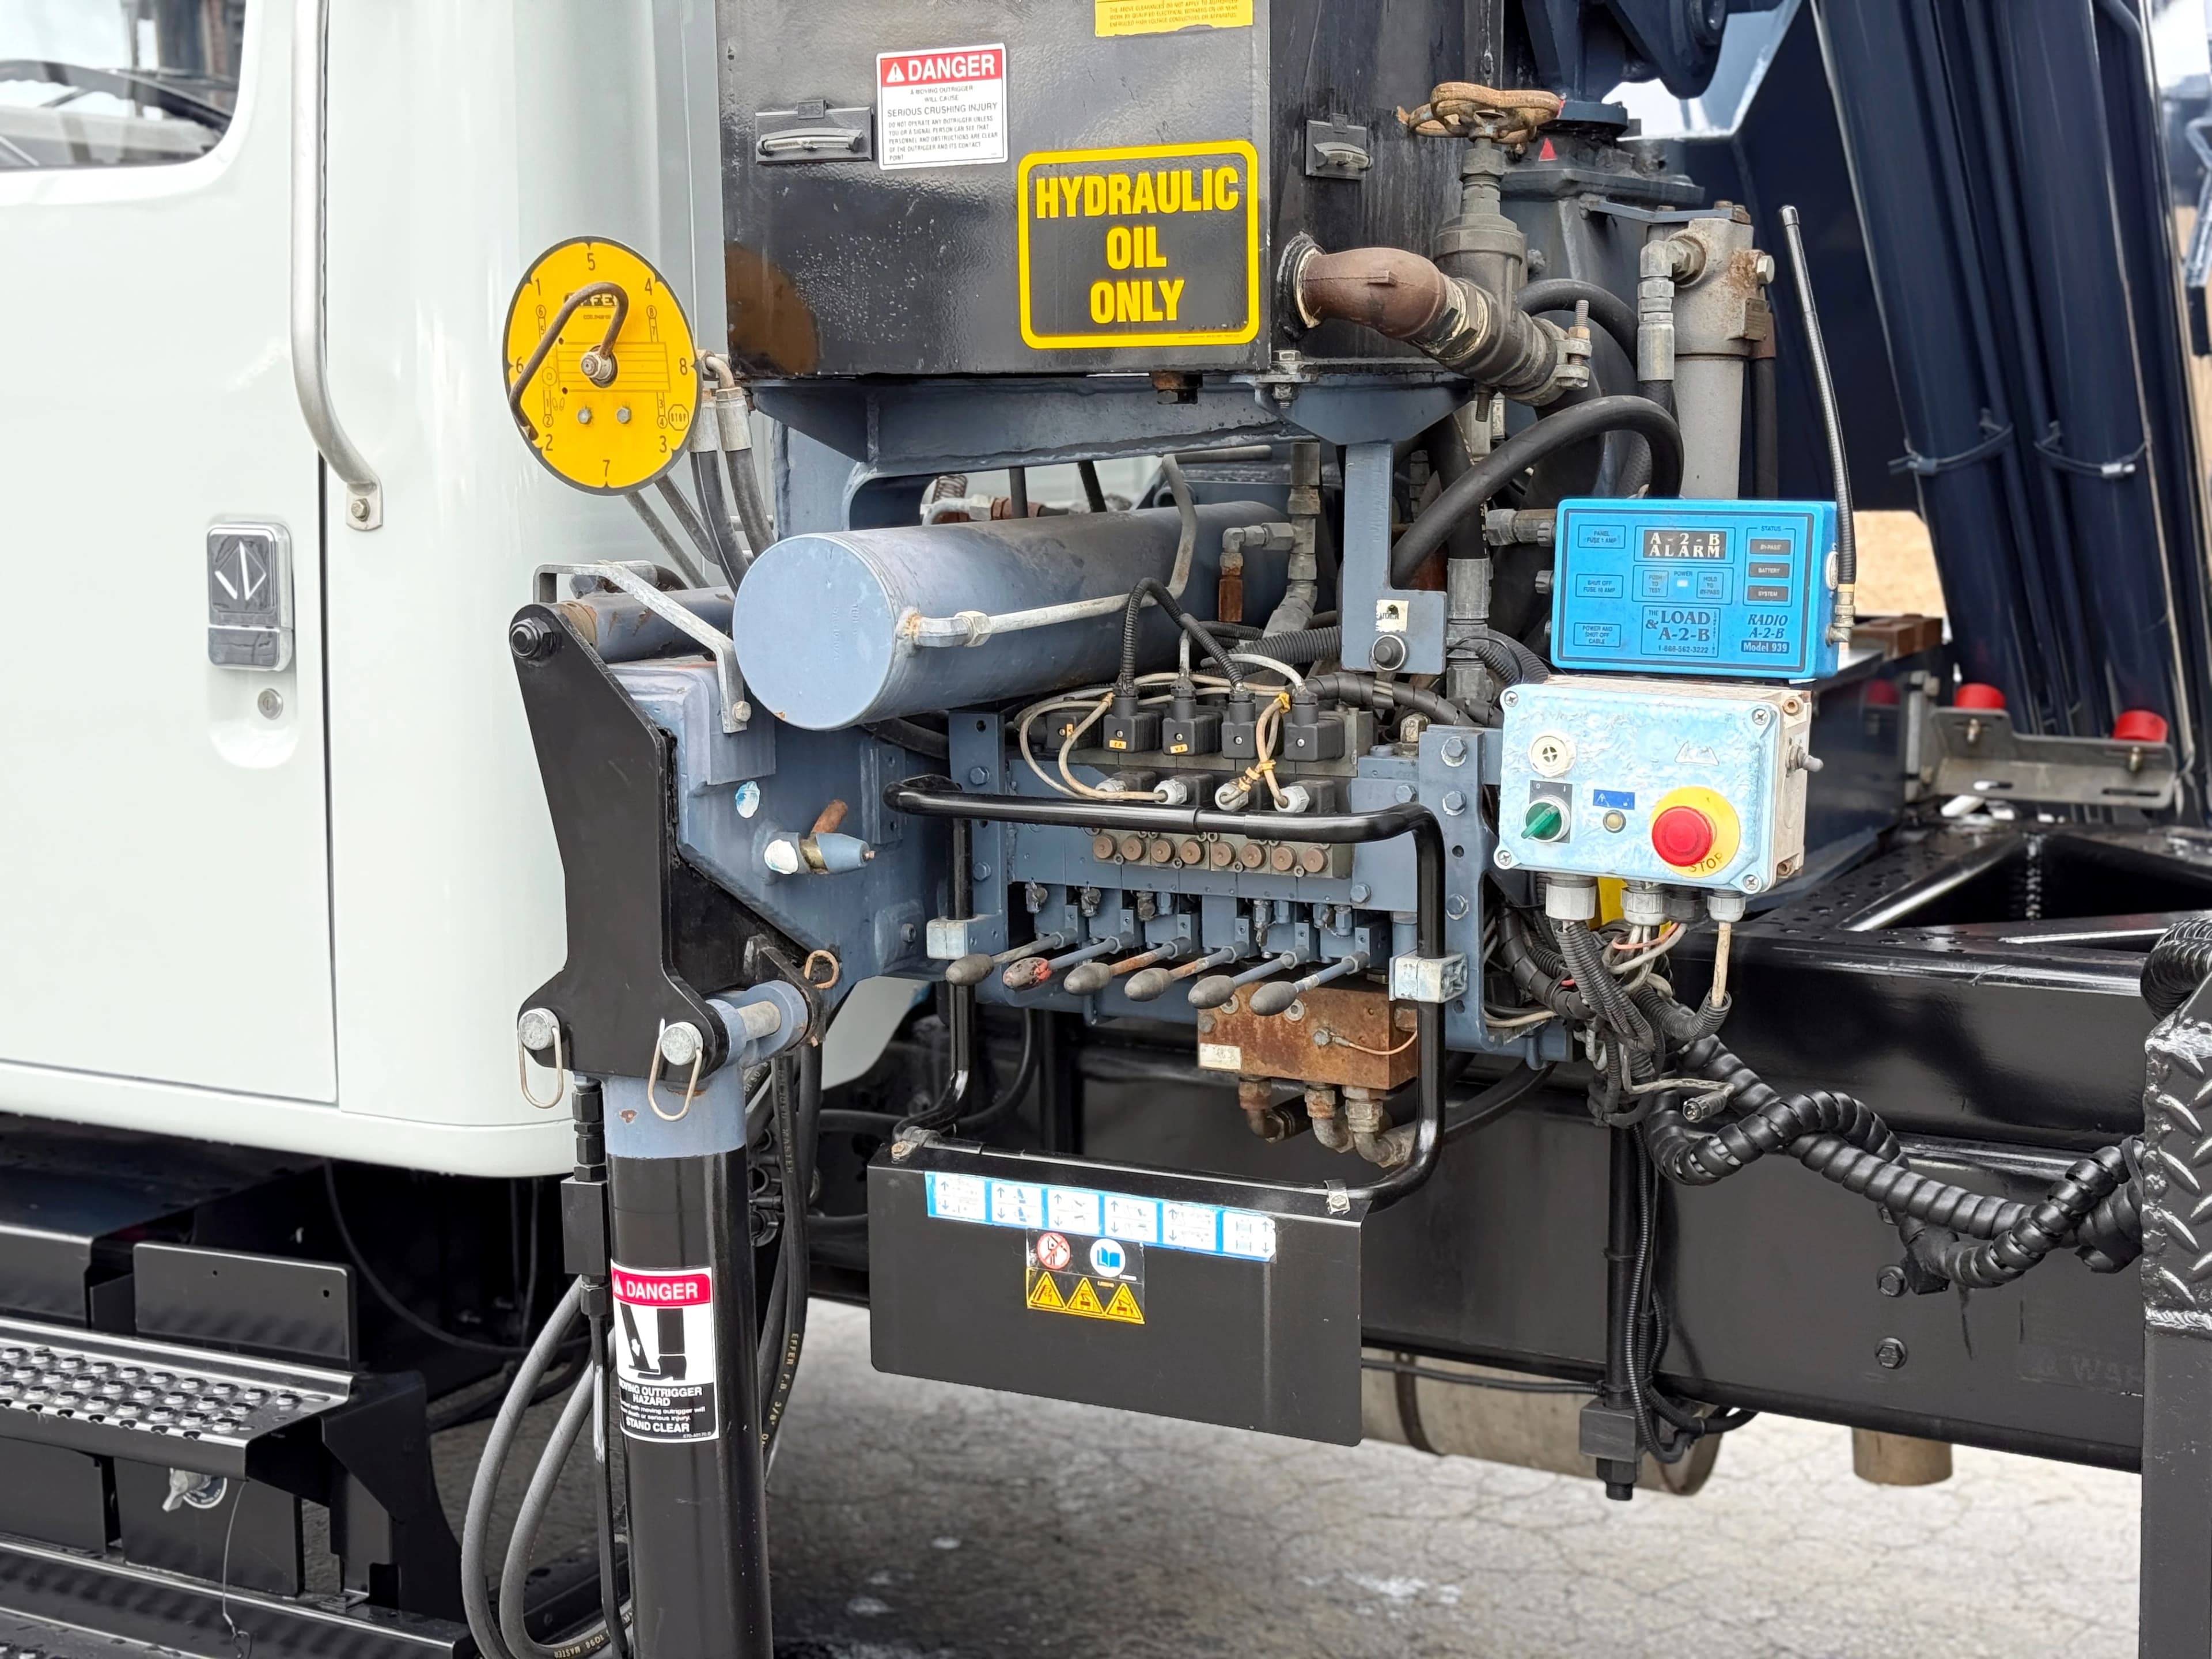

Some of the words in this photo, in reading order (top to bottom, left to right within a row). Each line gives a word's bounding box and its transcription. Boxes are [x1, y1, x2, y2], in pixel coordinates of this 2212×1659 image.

[908, 54, 995, 82] DANGER
[940, 85, 974, 93] OUTRIGGER
[887, 107, 922, 118] SERIOUS
[924, 104, 966, 115] CRUSHING
[968, 102, 998, 112] INJURY
[931, 134, 969, 142] OBSTRUCTIONS
[907, 144, 936, 153] OUTRIGGER
[1036, 166, 1239, 219] HYDRAULIC
[1106, 226, 1168, 270] OIL
[587, 252, 596, 271] 5
[535, 278, 541, 296] 1
[644, 278, 653, 296] 4
[1089, 279, 1185, 324] ONLY
[538, 308, 544, 316] 6
[516, 357, 525, 374] 6
[680, 357, 688, 376] 8
[671, 412, 687, 422] STOP
[546, 434, 553, 452] 2
[659, 435, 667, 453] 3
[603, 459, 611, 478] 7
[1649, 544, 1720, 558] ALARM
[1661, 610, 1711, 625] LOAD
[1748, 614, 1789, 626] RADIO
[1645, 619, 1658, 630] &
[1658, 627, 1710, 642] A-2-B
[1749, 627, 1785, 639] A-2-B
[1743, 643, 1769, 652] Model
[1771, 643, 1787, 653] 939
[1688, 851, 1725, 873] STOP
[782, 1128, 794, 1173] MASTER
[626, 1280, 698, 1300] DANGER
[786, 1332, 800, 1365] EFFER
[633, 1394, 671, 1406] HAZARD
[642, 1387, 702, 1397] OUTRIGGER
[641, 1406, 661, 1415] moving
[626, 1416, 651, 1431] STAND
[653, 1423, 690, 1433] CLEAR
[554, 1645, 581, 1659] MASTER
